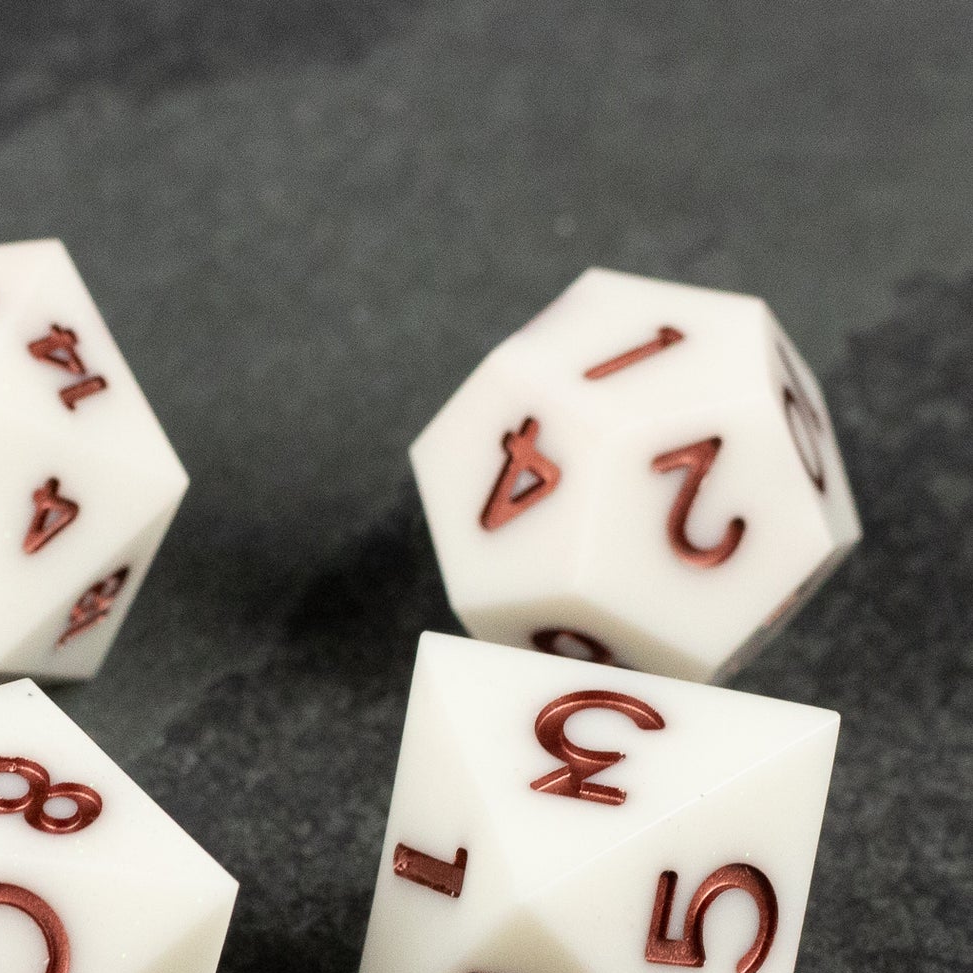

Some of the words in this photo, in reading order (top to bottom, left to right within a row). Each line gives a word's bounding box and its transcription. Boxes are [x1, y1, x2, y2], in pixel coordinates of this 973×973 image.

[27, 324, 109, 411] 14
[583, 326, 686, 382] 1
[21, 476, 80, 556] 4
[478, 416, 563, 534] 4
[650, 436, 747, 571] 2
[529, 688, 667, 808] 3
[392, 841, 469, 900] 1
